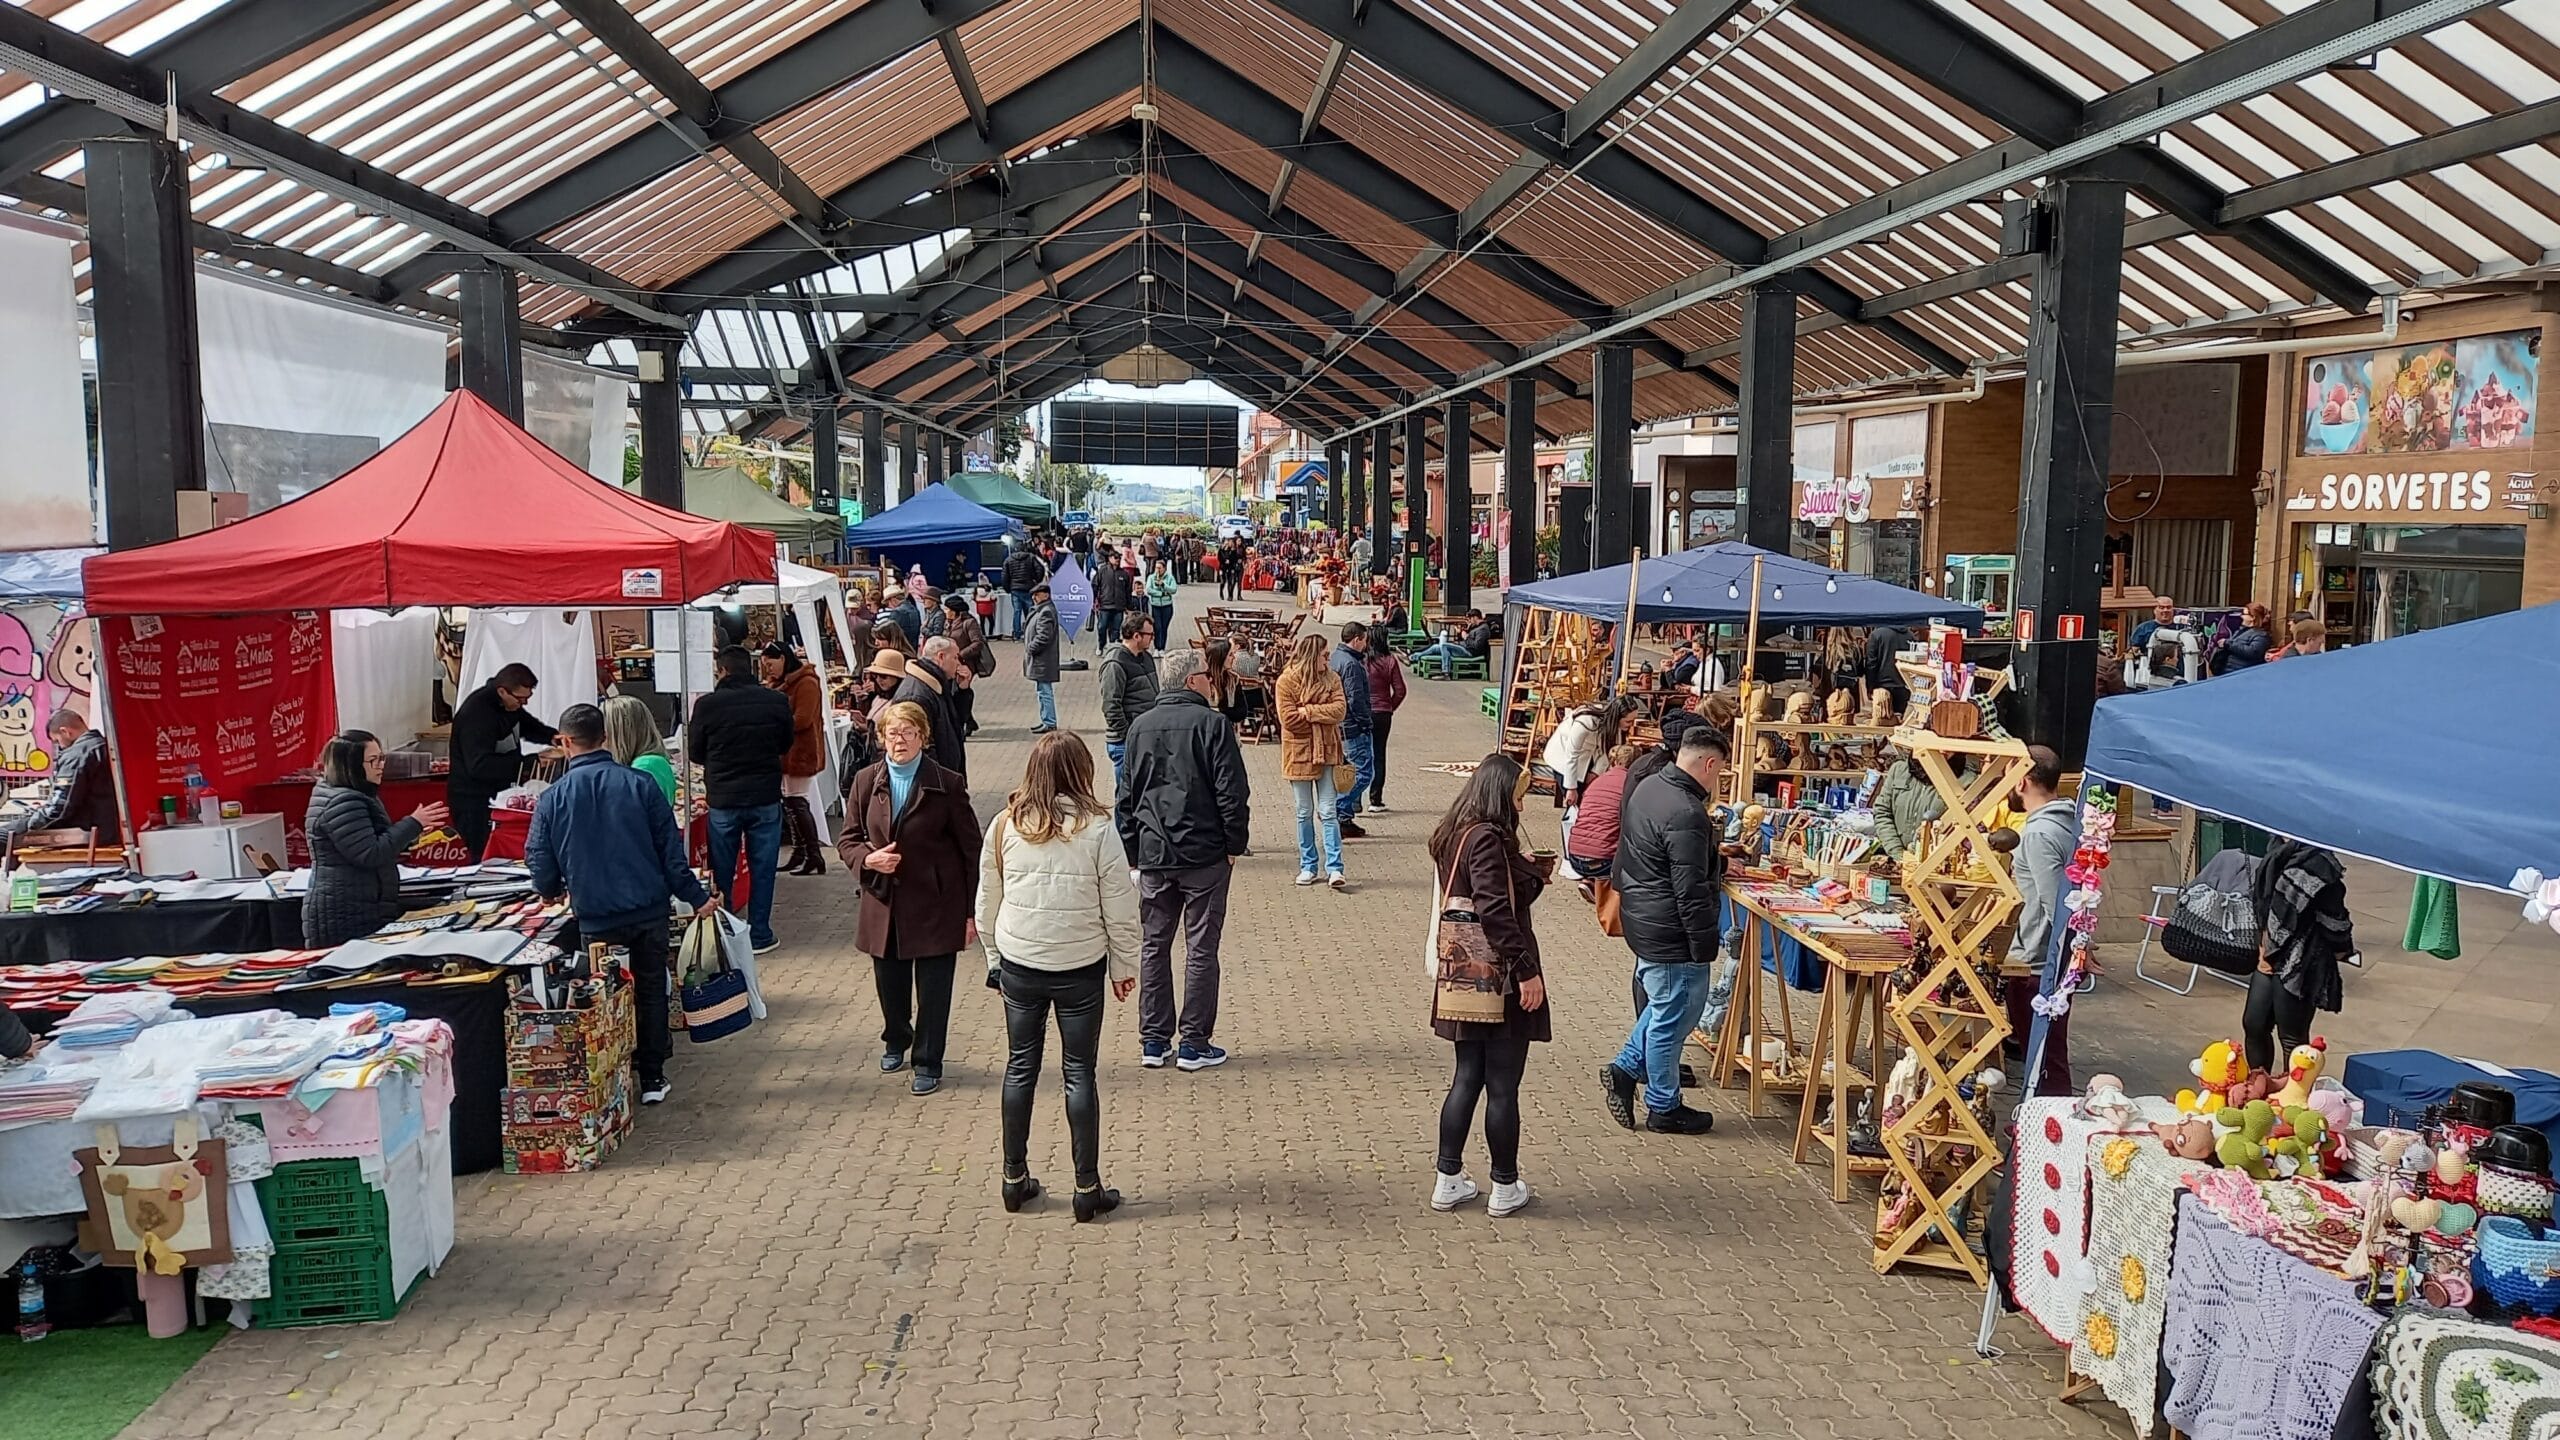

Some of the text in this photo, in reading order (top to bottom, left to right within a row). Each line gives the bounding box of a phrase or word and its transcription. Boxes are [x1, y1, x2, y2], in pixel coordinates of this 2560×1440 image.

[2320, 470, 2492, 511] SORVETES
[2508, 476, 2534, 489] ÁGUA
[1800, 480, 1839, 516] Sweet
[134, 655, 162, 676] Melos
[194, 652, 220, 673] Melos
[250, 644, 274, 667] Melos
[173, 738, 201, 760] Melos
[231, 728, 256, 751] Melos
[415, 841, 468, 860] Melos
